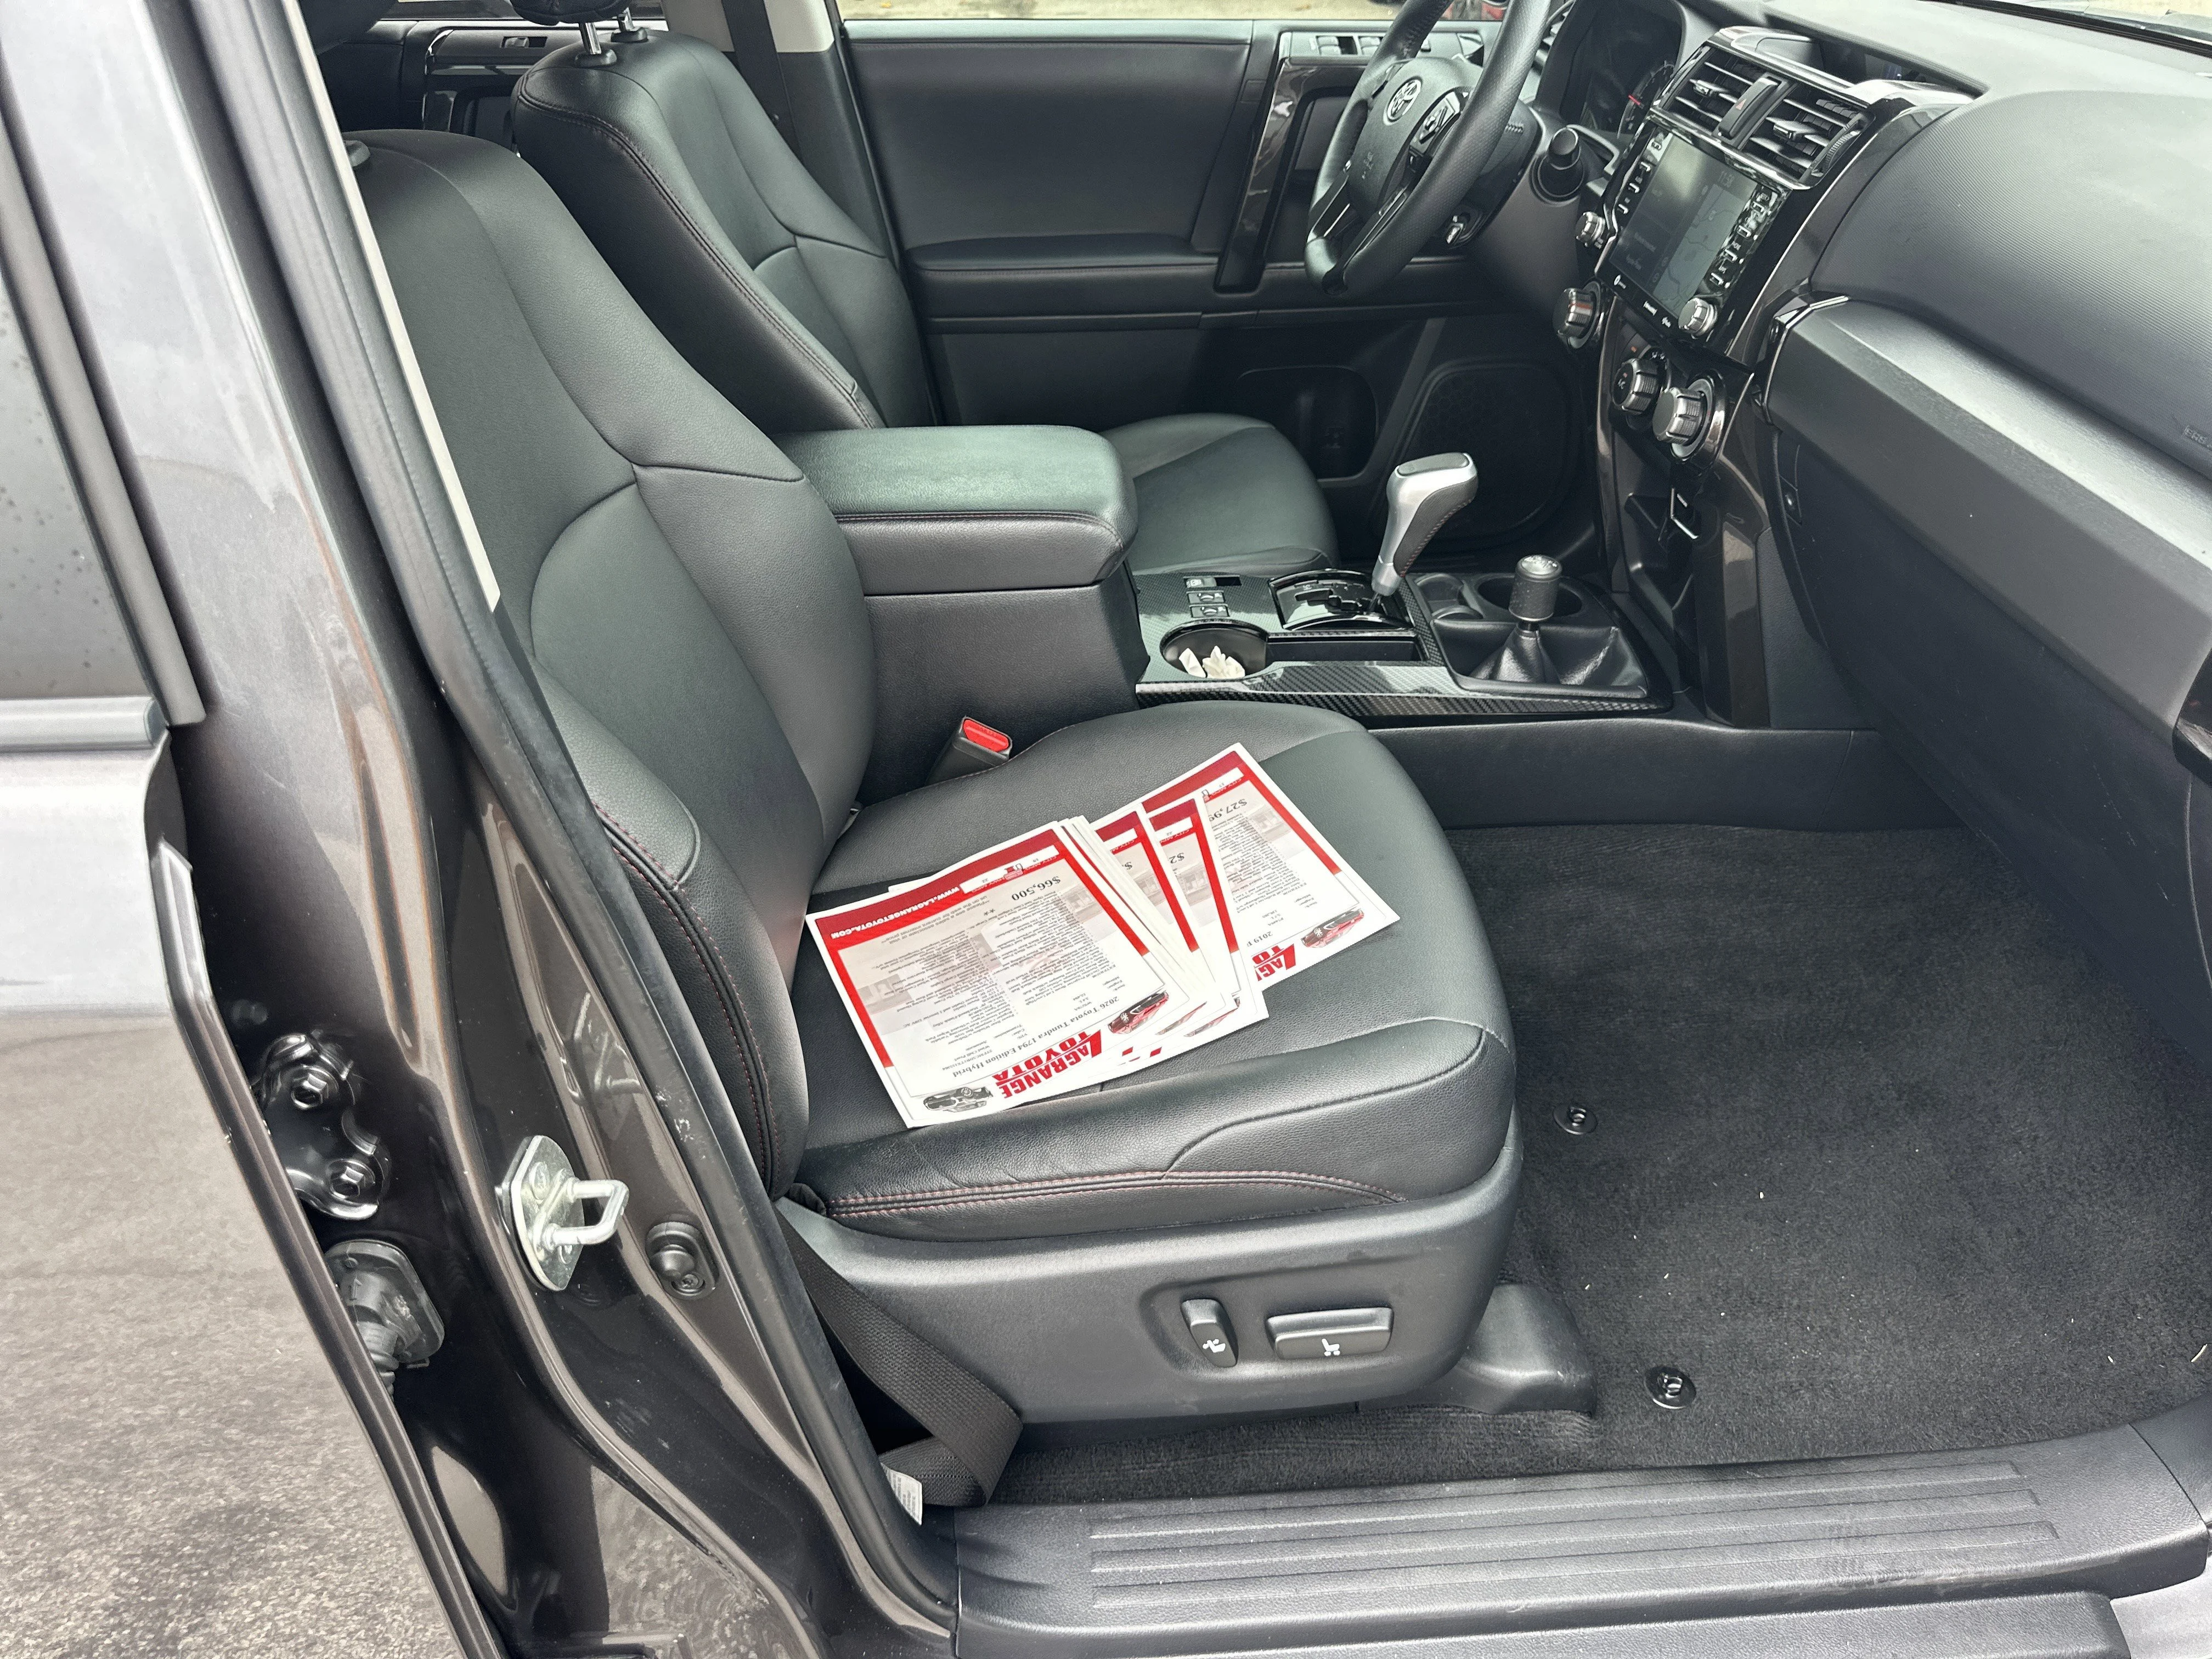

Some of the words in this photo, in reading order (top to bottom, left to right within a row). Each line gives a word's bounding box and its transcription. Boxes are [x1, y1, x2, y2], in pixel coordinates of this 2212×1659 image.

[1010, 875, 1062, 901] $66,500
[830, 885, 960, 939] WWW.LAGRANGETOYOTA.COM
[1252, 930, 1273, 944] 2019
[1098, 995, 1119, 1009] 2026
[1069, 1006, 1099, 1024] Toyota
[1037, 1020, 1070, 1040] Tundra
[1016, 1036, 1036, 1049] 1794
[984, 1046, 1016, 1065] Edition
[992, 1031, 1091, 1081] TOYOTA
[998, 1029, 1102, 1099] LAGRANGE
[952, 1061, 984, 1077] Hybrid
